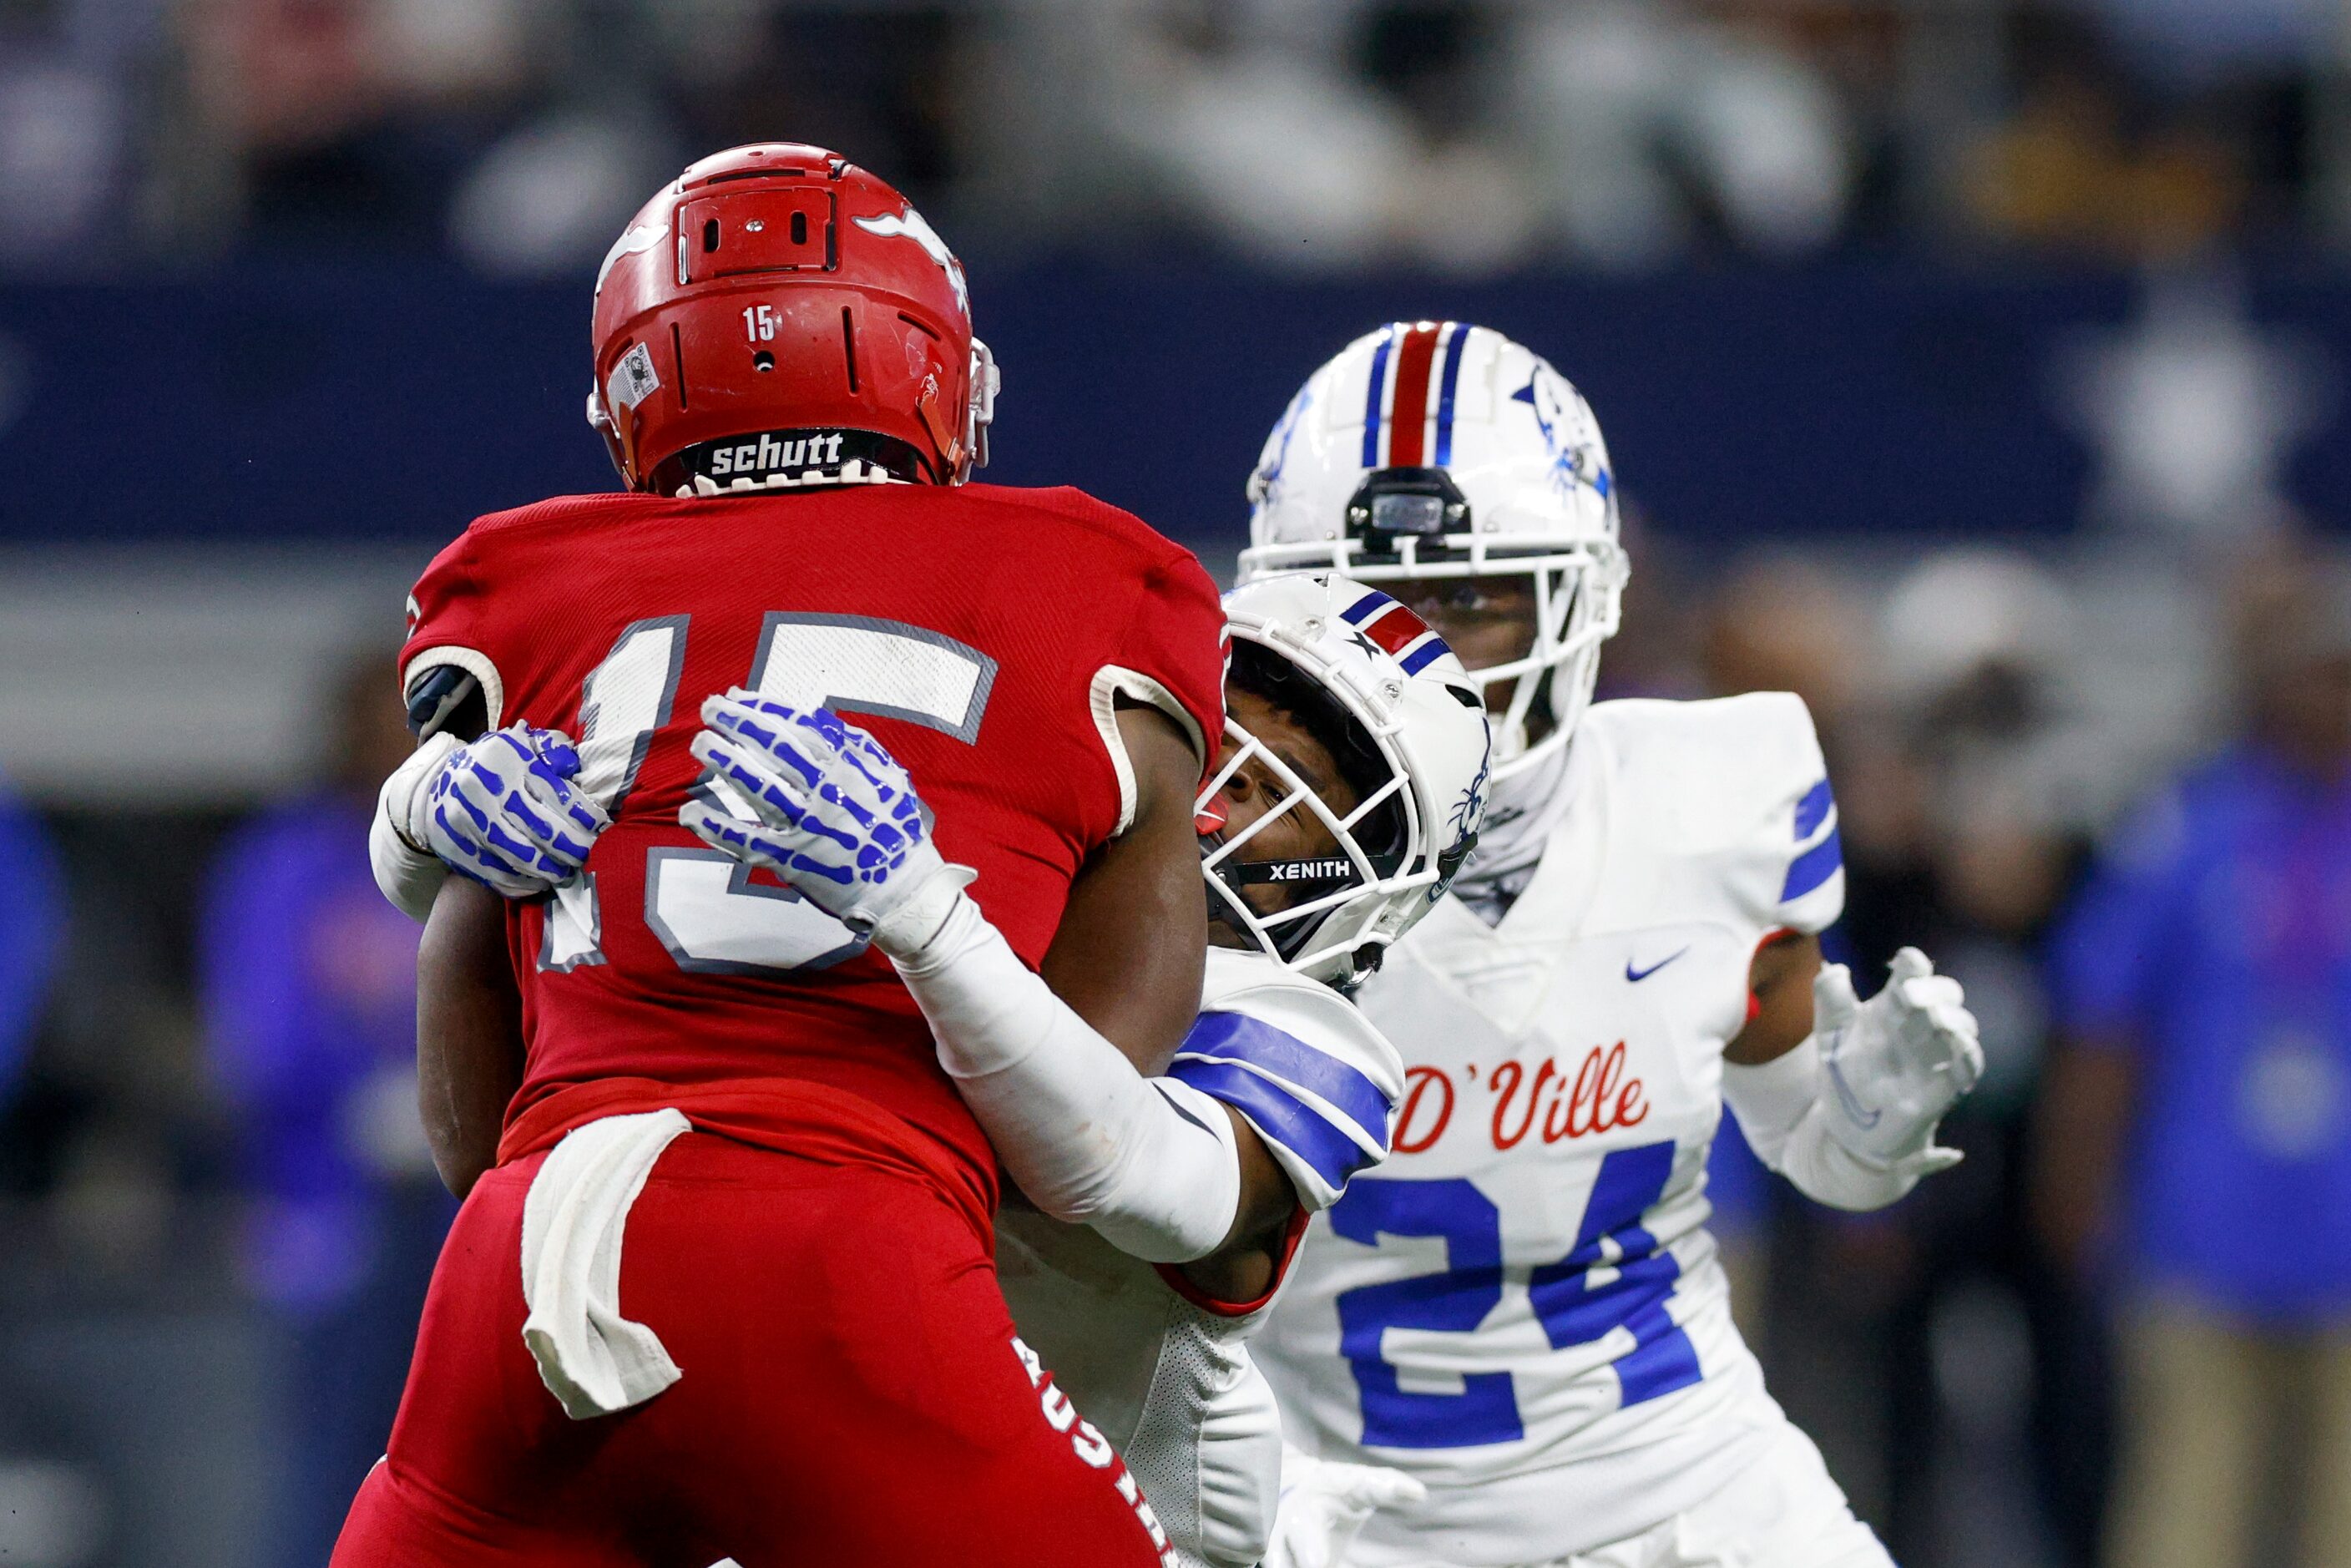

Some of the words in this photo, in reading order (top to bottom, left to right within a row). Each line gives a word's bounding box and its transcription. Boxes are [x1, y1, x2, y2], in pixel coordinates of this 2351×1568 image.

[743, 306, 773, 341] 15
[712, 434, 843, 475] schutt
[536, 610, 998, 974] 15
[1269, 860, 1350, 881] XENITH
[1393, 1039, 1649, 1154] D'Ville
[1328, 1141, 1703, 1447] 24
